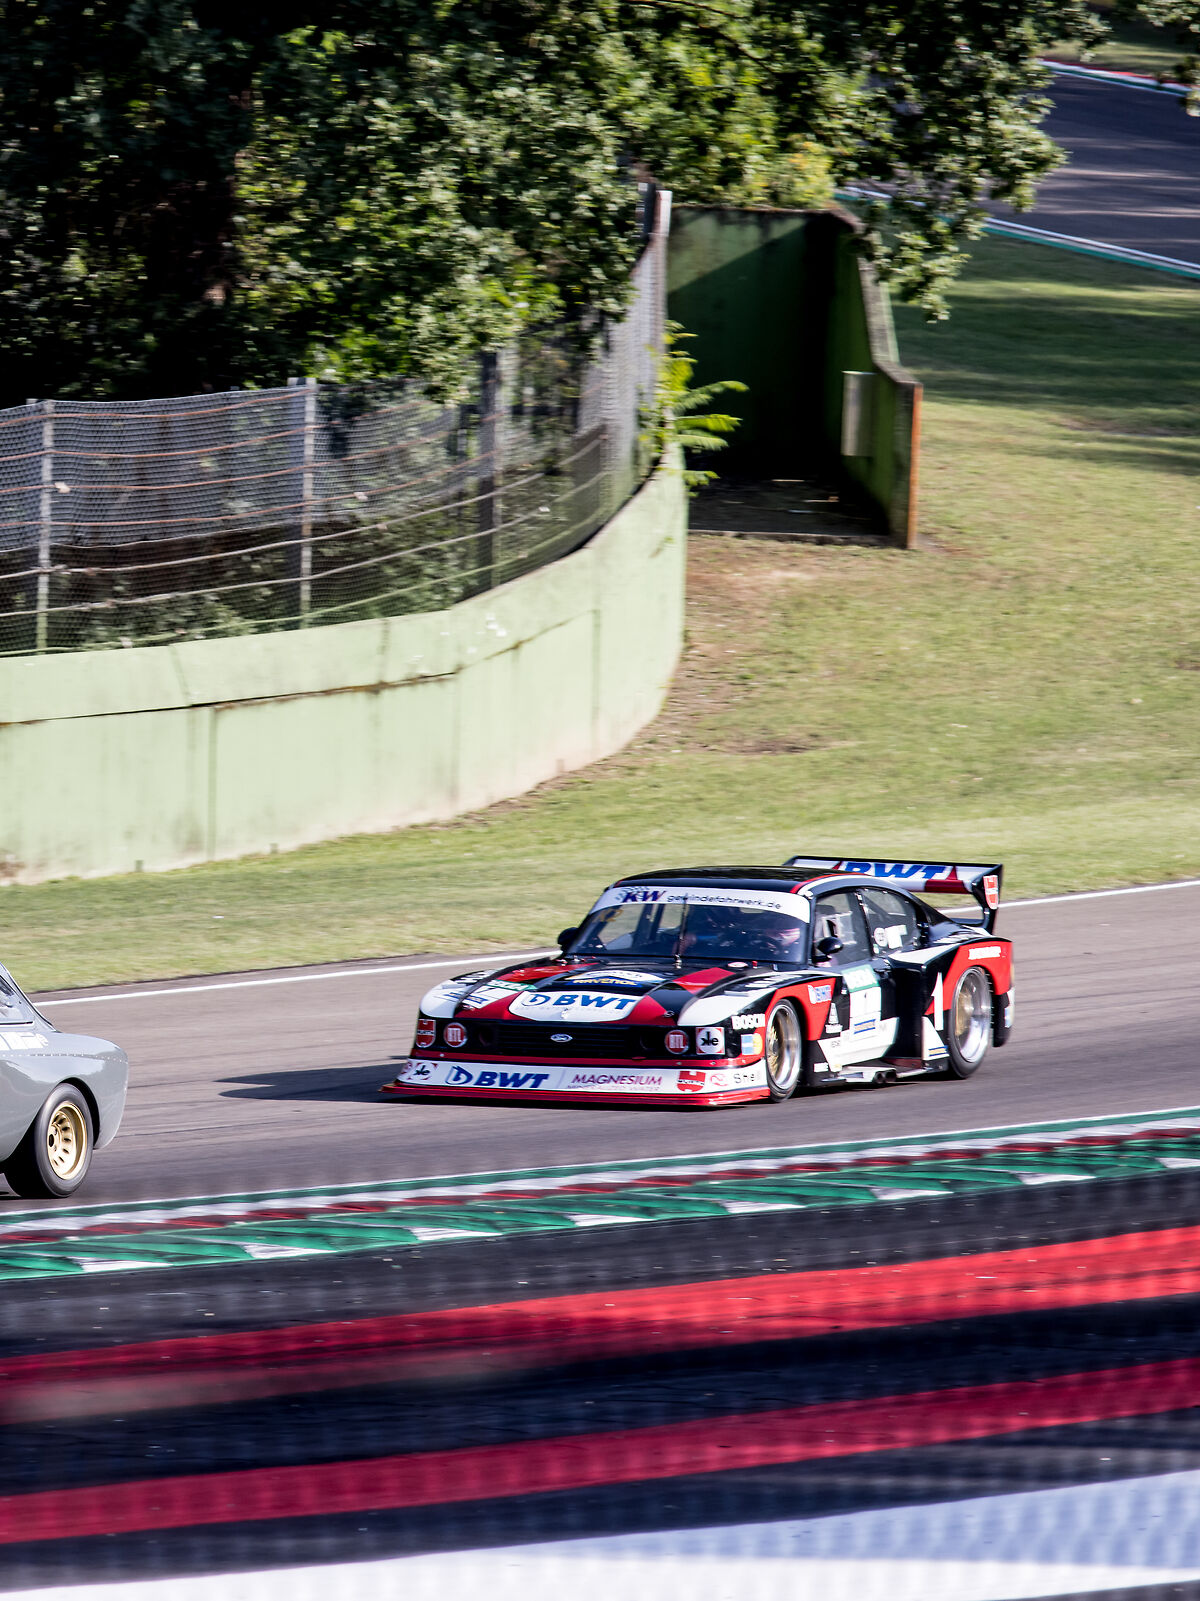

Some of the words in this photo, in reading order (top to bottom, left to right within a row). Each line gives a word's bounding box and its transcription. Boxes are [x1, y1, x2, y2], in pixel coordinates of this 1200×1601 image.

[622, 890, 667, 903] KW
[553, 994, 636, 1010] BWT
[931, 971, 944, 1031] 1
[474, 1071, 550, 1089] BWT
[571, 1074, 663, 1086] MAGNESIUM
